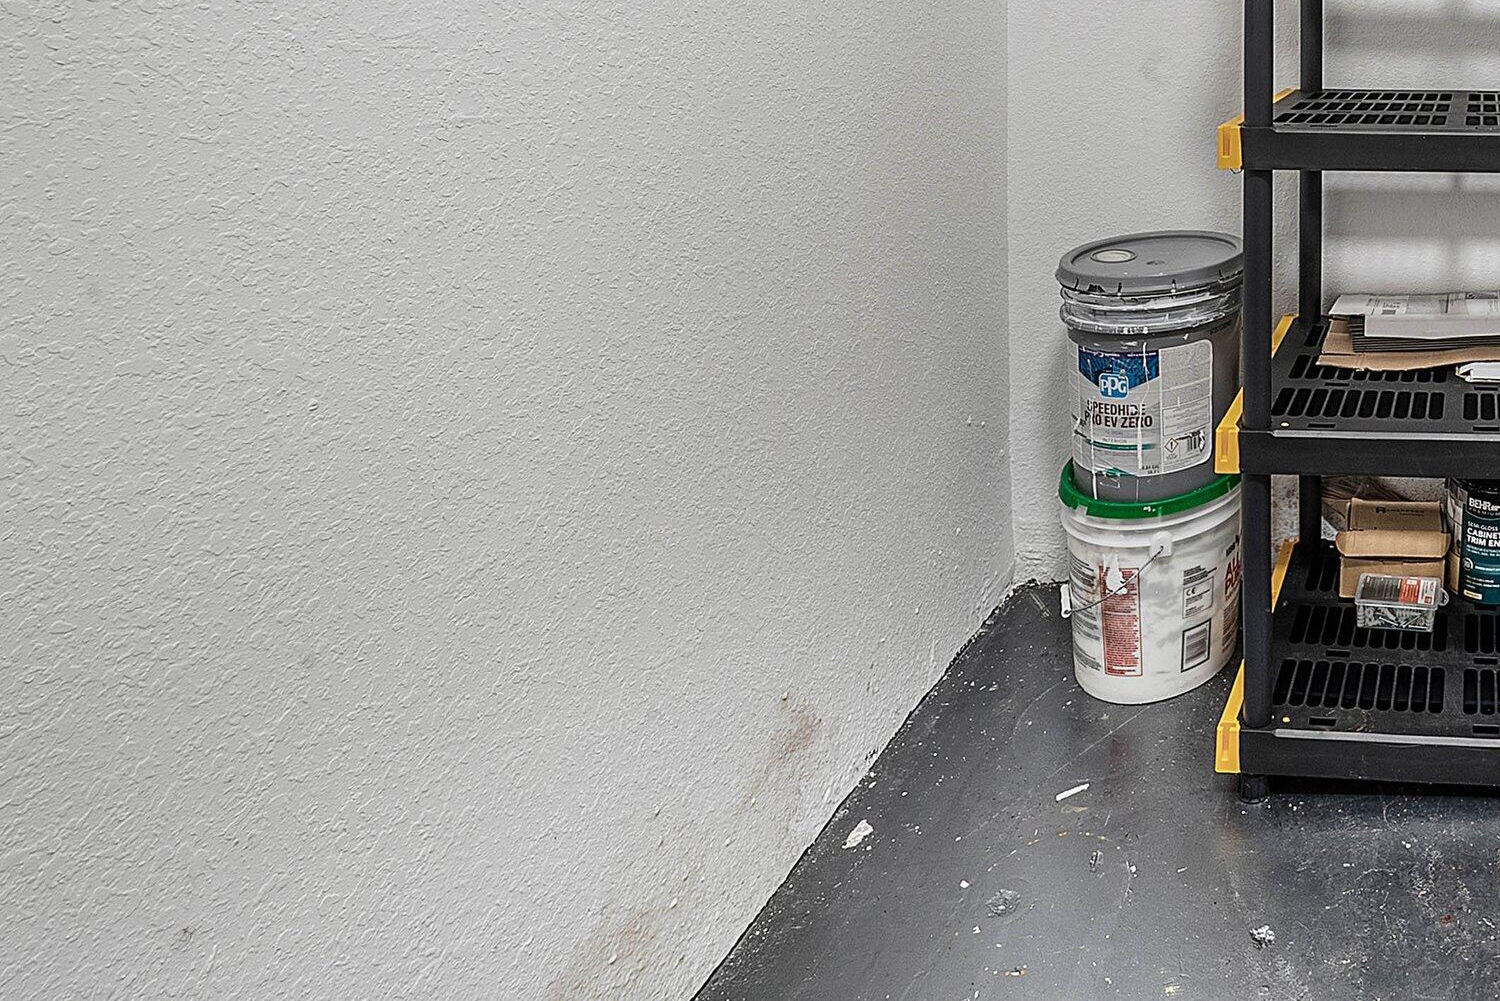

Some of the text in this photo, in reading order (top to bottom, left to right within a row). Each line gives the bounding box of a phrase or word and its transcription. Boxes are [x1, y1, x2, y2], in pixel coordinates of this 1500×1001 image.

[1101, 377, 1127, 395] PPG
[1105, 416, 1118, 428] EV
[1120, 415, 1153, 429] ZERO
[1469, 497, 1491, 511] BEHR
[1466, 534, 1487, 547] TRIM
